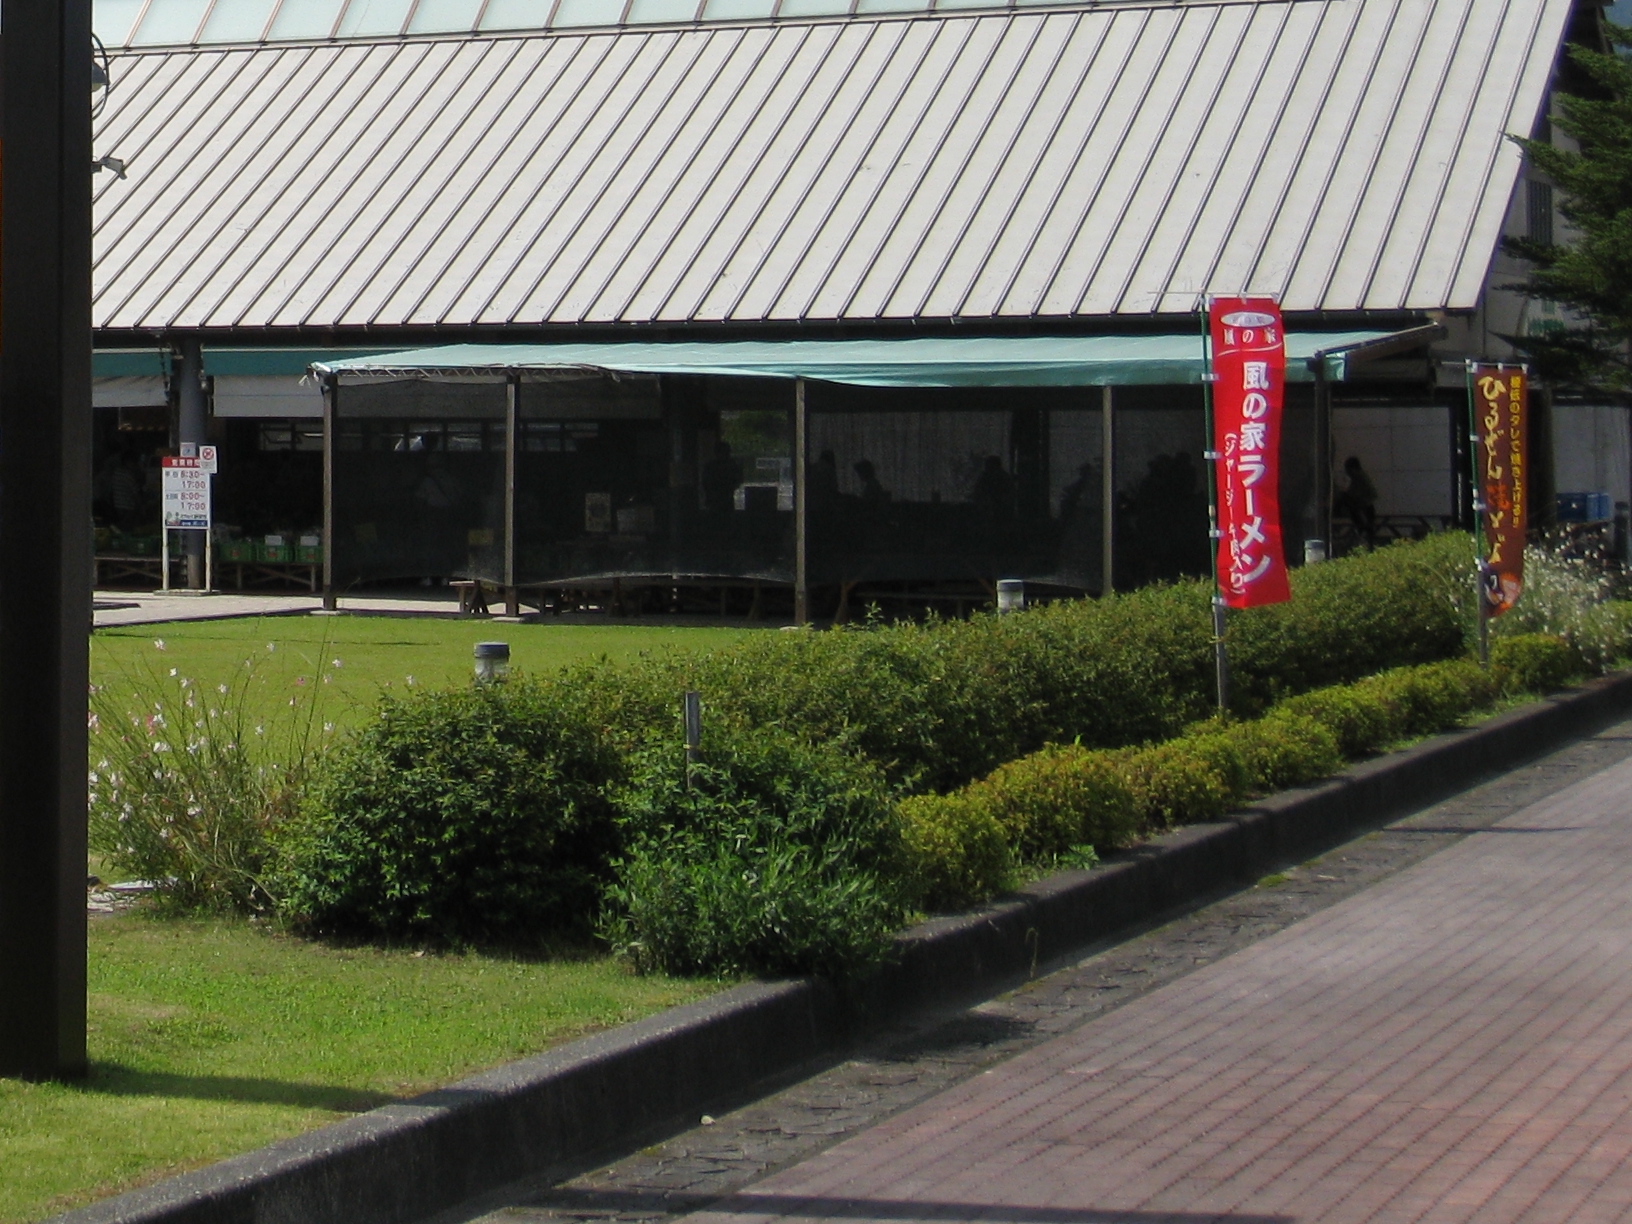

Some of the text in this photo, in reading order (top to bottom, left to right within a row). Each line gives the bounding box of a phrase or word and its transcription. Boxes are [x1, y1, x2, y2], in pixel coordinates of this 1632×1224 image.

[1238, 361, 1271, 584] 風の家ラーメン
